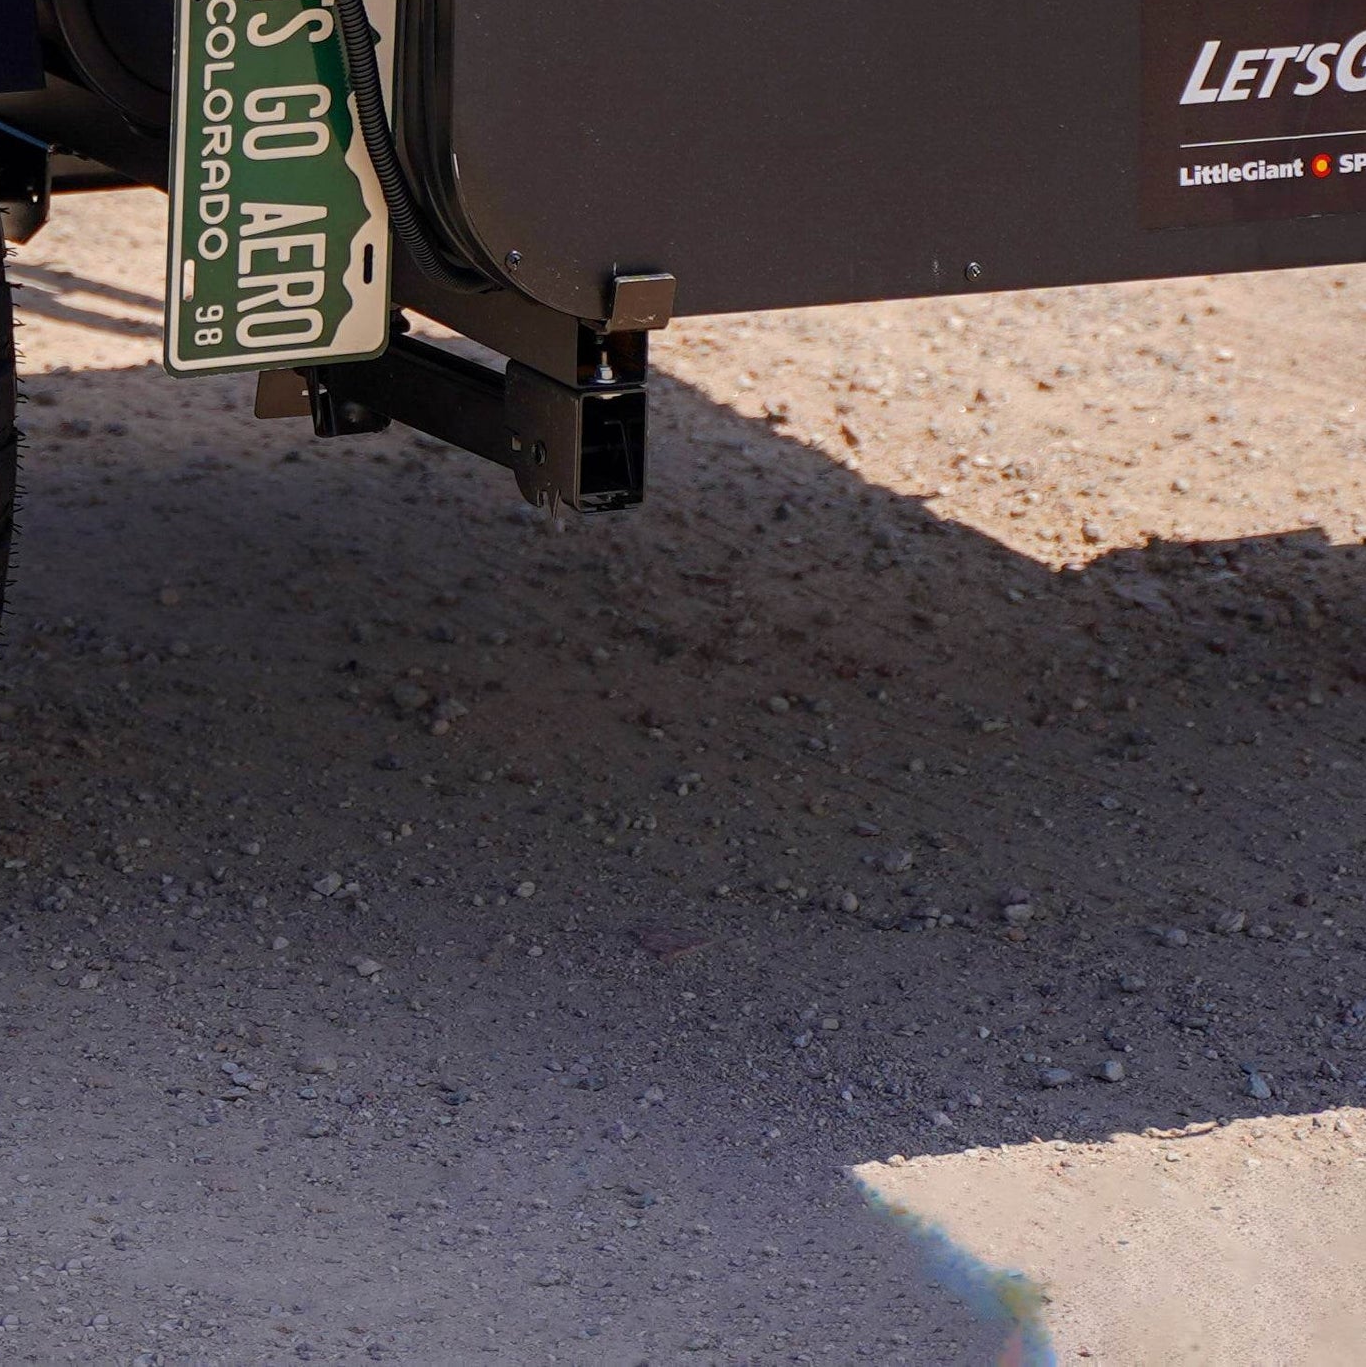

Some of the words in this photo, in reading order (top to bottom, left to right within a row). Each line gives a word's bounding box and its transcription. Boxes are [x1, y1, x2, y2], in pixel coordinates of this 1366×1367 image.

[242, 84, 331, 160] GO
[1179, 158, 1305, 186] LittleGiant
[235, 201, 328, 349] AERO
[193, 304, 223, 346] 98
